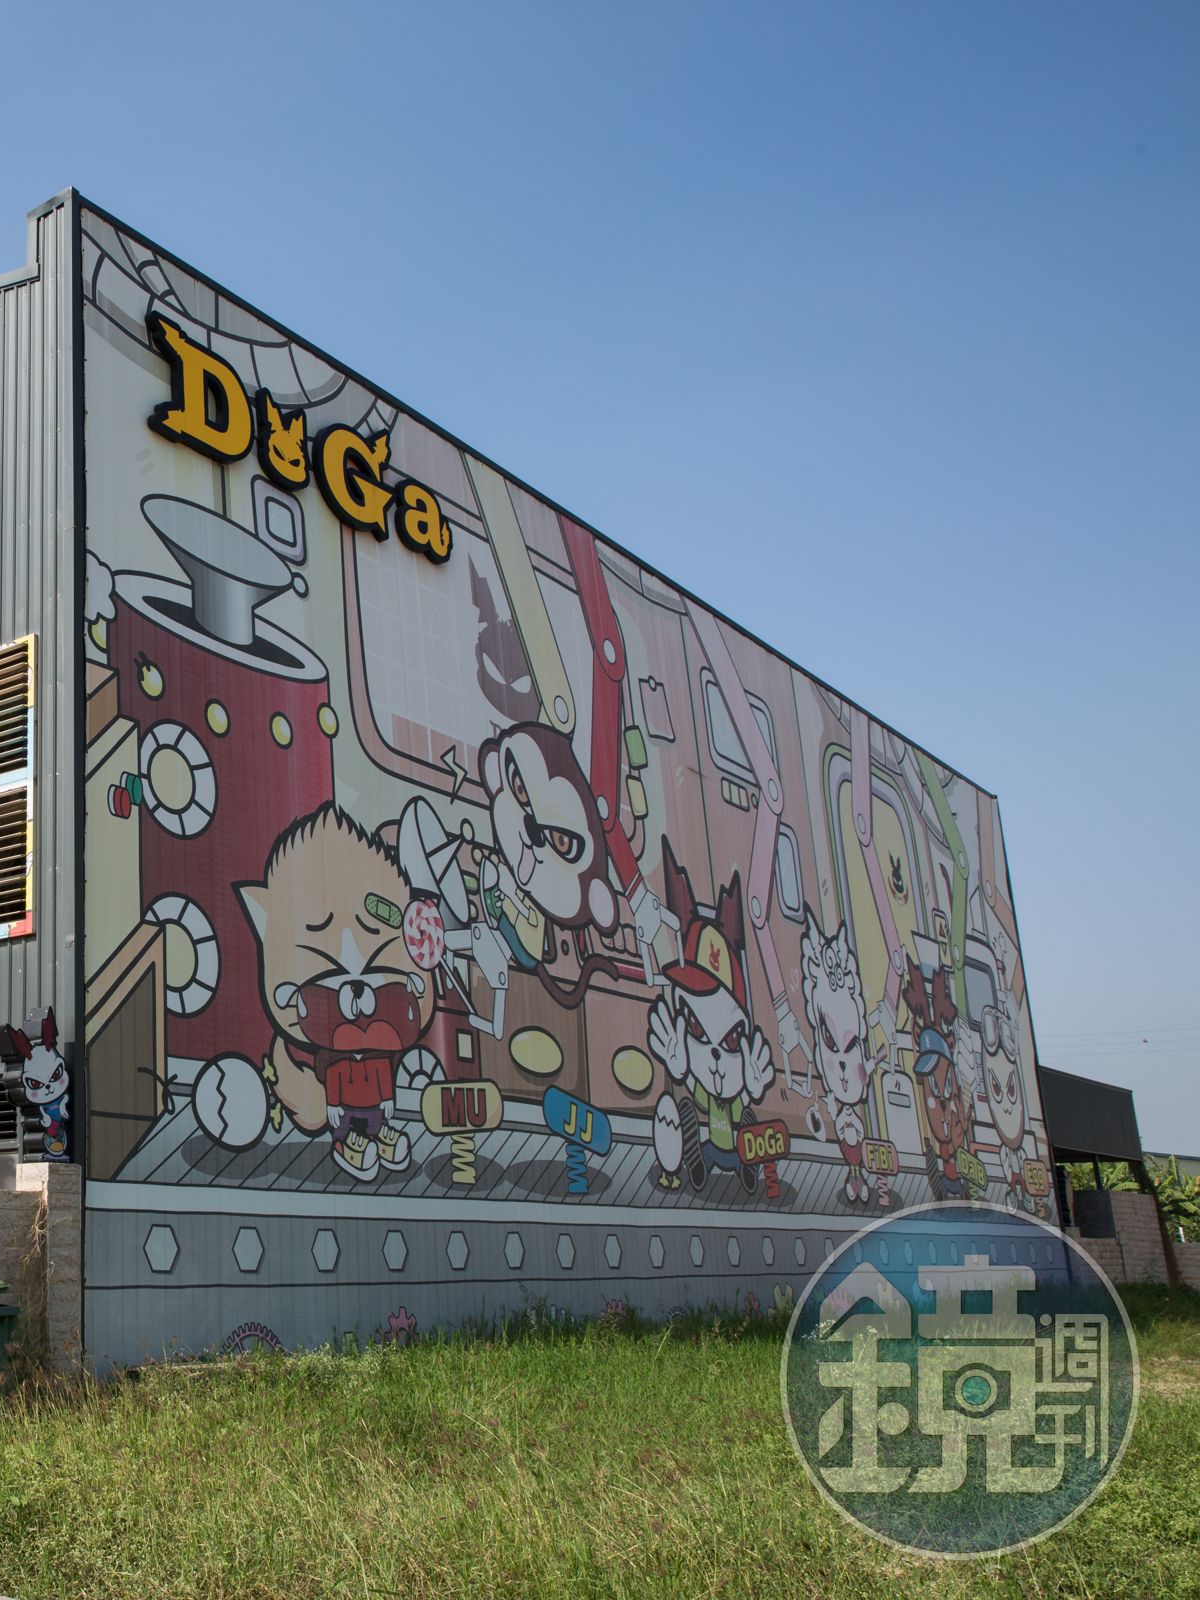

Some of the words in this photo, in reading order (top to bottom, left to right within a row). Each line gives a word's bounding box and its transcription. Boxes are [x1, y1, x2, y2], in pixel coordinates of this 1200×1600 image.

[440, 1086, 487, 1128] MU
[563, 1101, 594, 1144] JJ
[743, 1127, 785, 1161] DoGa
[960, 1150, 986, 1187] DaB
[1027, 1162, 1046, 1192] Egg
